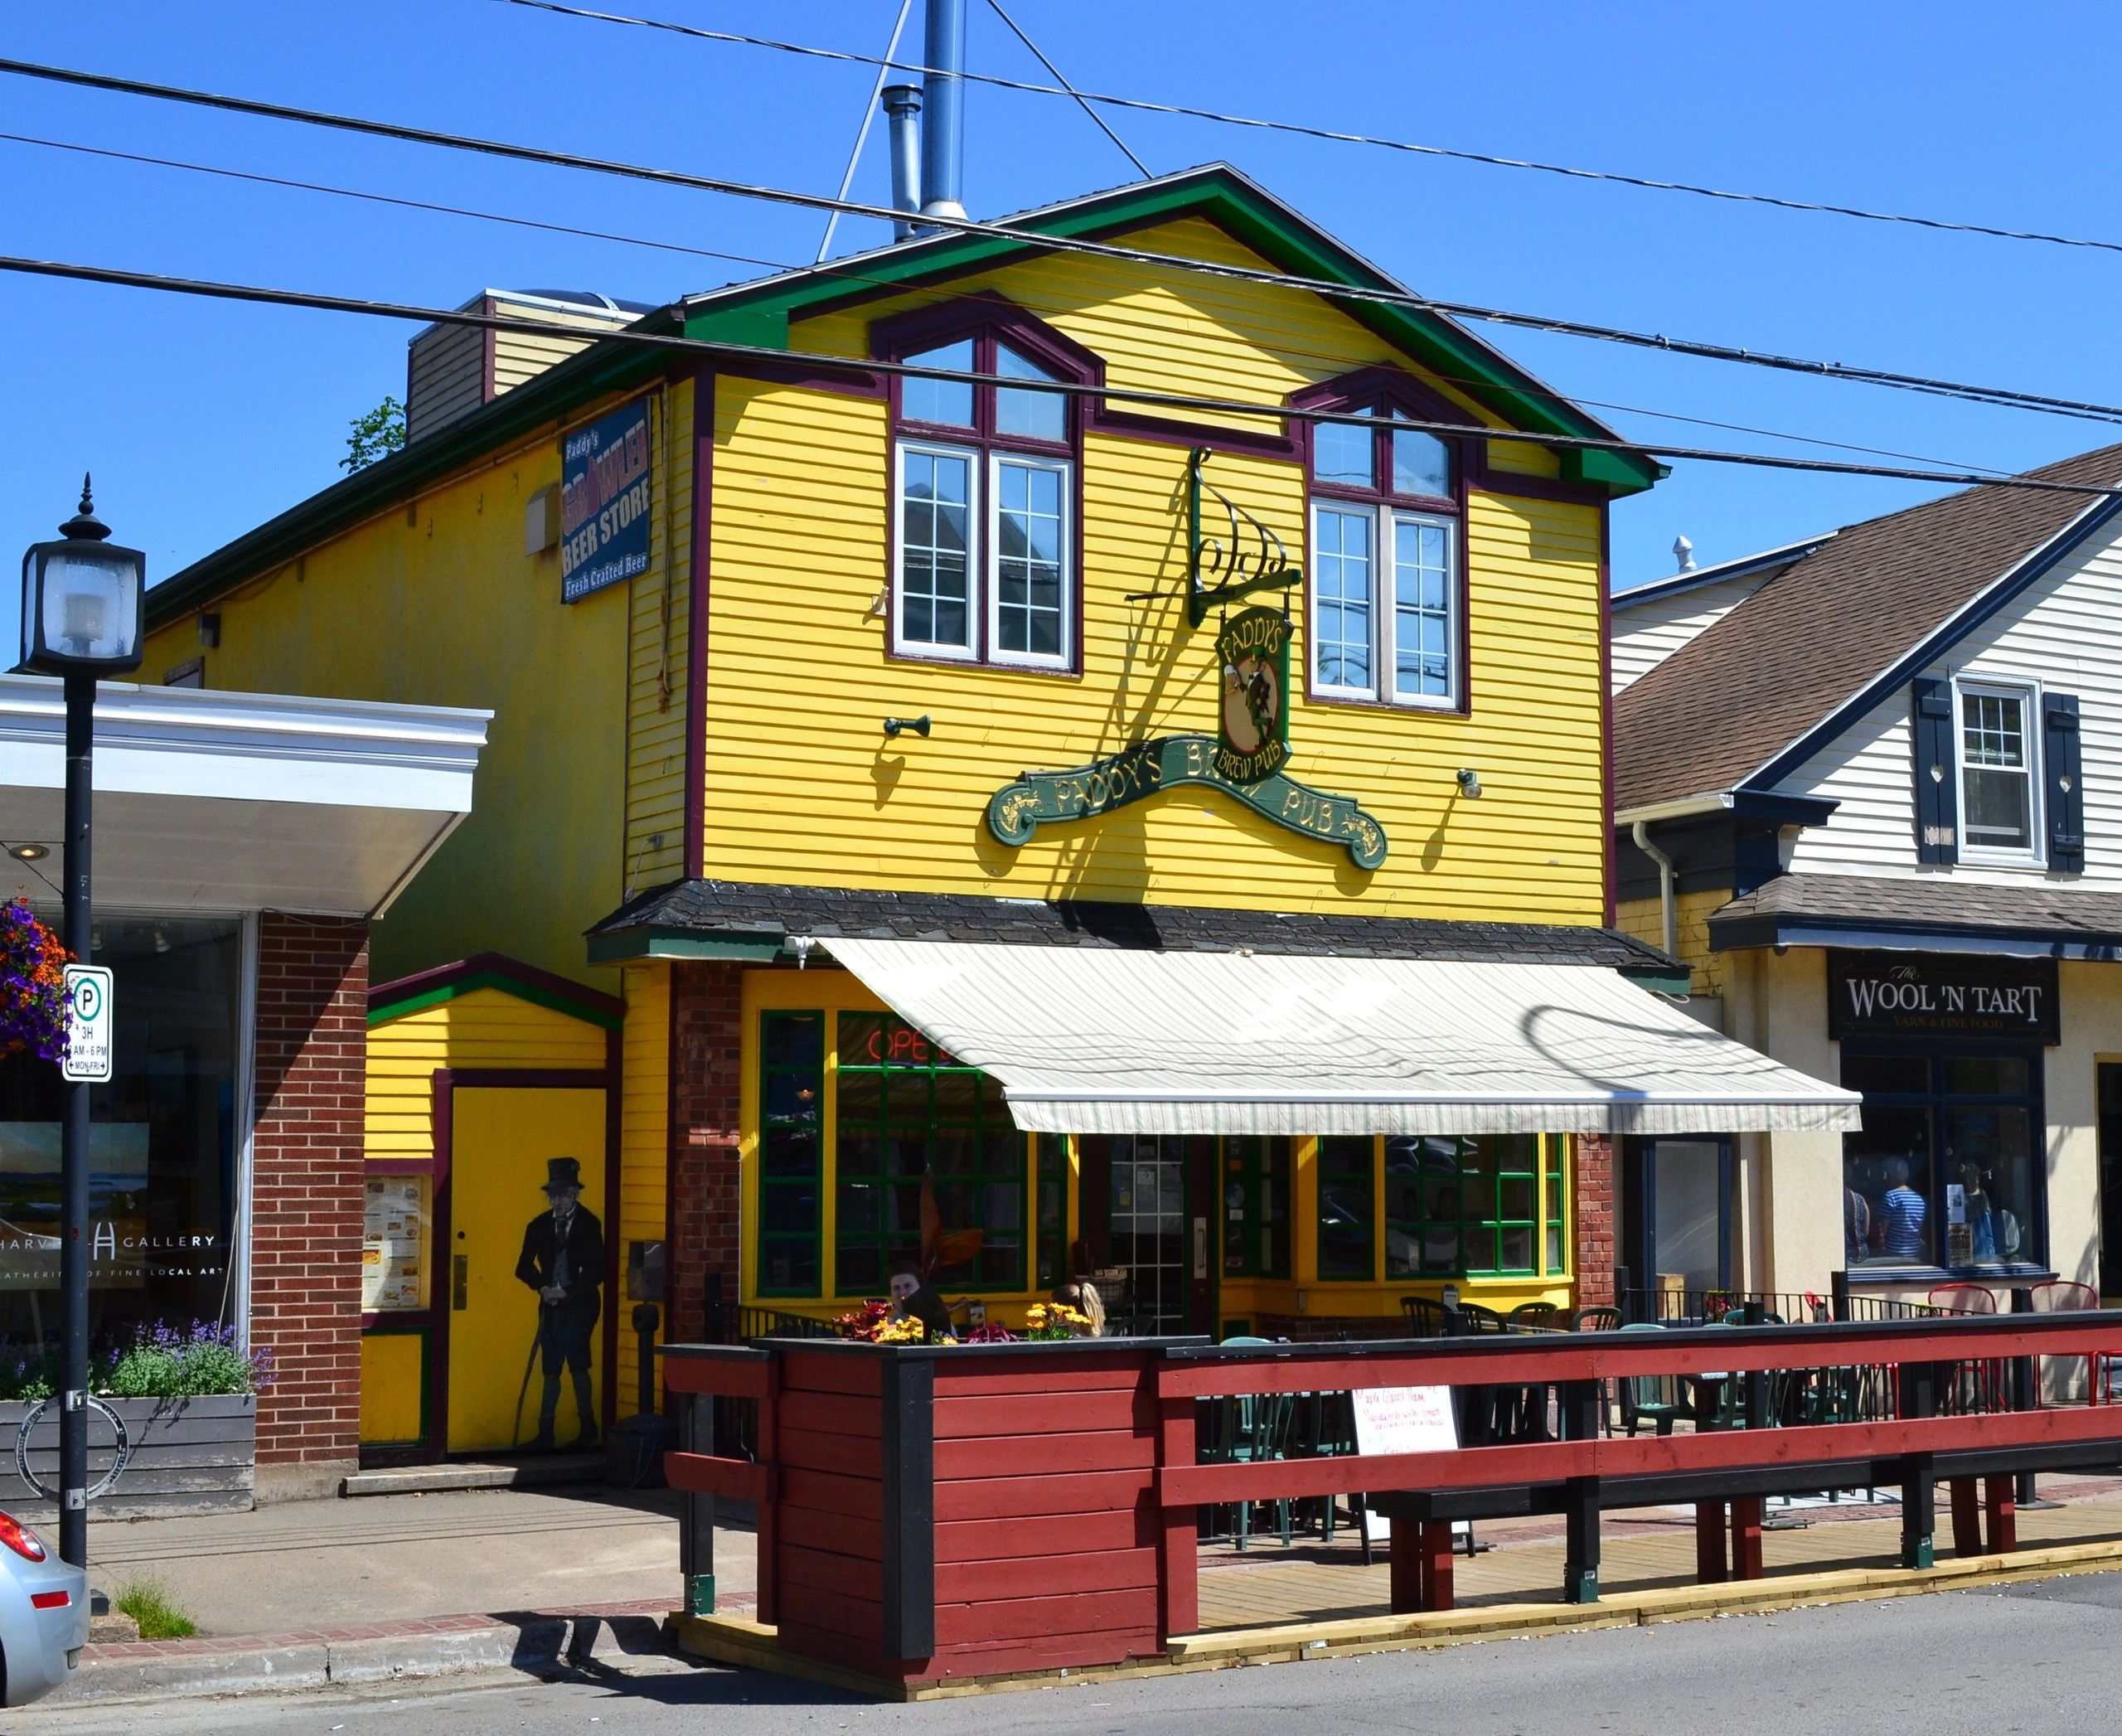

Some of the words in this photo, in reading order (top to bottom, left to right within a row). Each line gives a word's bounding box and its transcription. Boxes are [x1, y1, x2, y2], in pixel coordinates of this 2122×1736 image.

[565, 430, 599, 462] Paddy's
[563, 522, 598, 578] BEER
[600, 478, 649, 546] STORE
[565, 574, 589, 598] Fresh
[590, 560, 623, 588] Crafted
[625, 552, 647, 572] Beer
[1221, 617, 1283, 664] PADDY'S
[1218, 747, 1252, 781] BREW
[1255, 739, 1282, 777] PUB
[1054, 751, 1163, 813] PADDY'S
[1282, 788, 1335, 834] PUB
[1889, 965, 1921, 981] The
[1847, 978, 1936, 1018] WOOL
[1941, 985, 1966, 1012] 'N
[1971, 986, 2043, 1023] TART
[81, 1026, 94, 1040] 3H
[1894, 1016, 1926, 1028] YARN
[1929, 1017, 1938, 1028] &
[1940, 1017, 1969, 1029] FINE
[1971, 1019, 2004, 1030] FOOD
[73, 1045, 85, 1055] AM
[90, 1045, 95, 1056] 6
[96, 1045, 107, 1056] PM
[868, 1030, 950, 1061] OPE
[75, 1060, 100, 1070] MON-FRI
[123, 1235, 216, 1248] GALLERY
[110, 1269, 142, 1278] FINE
[150, 1268, 193, 1277] LOCAL
[199, 1267, 225, 1275] ART
